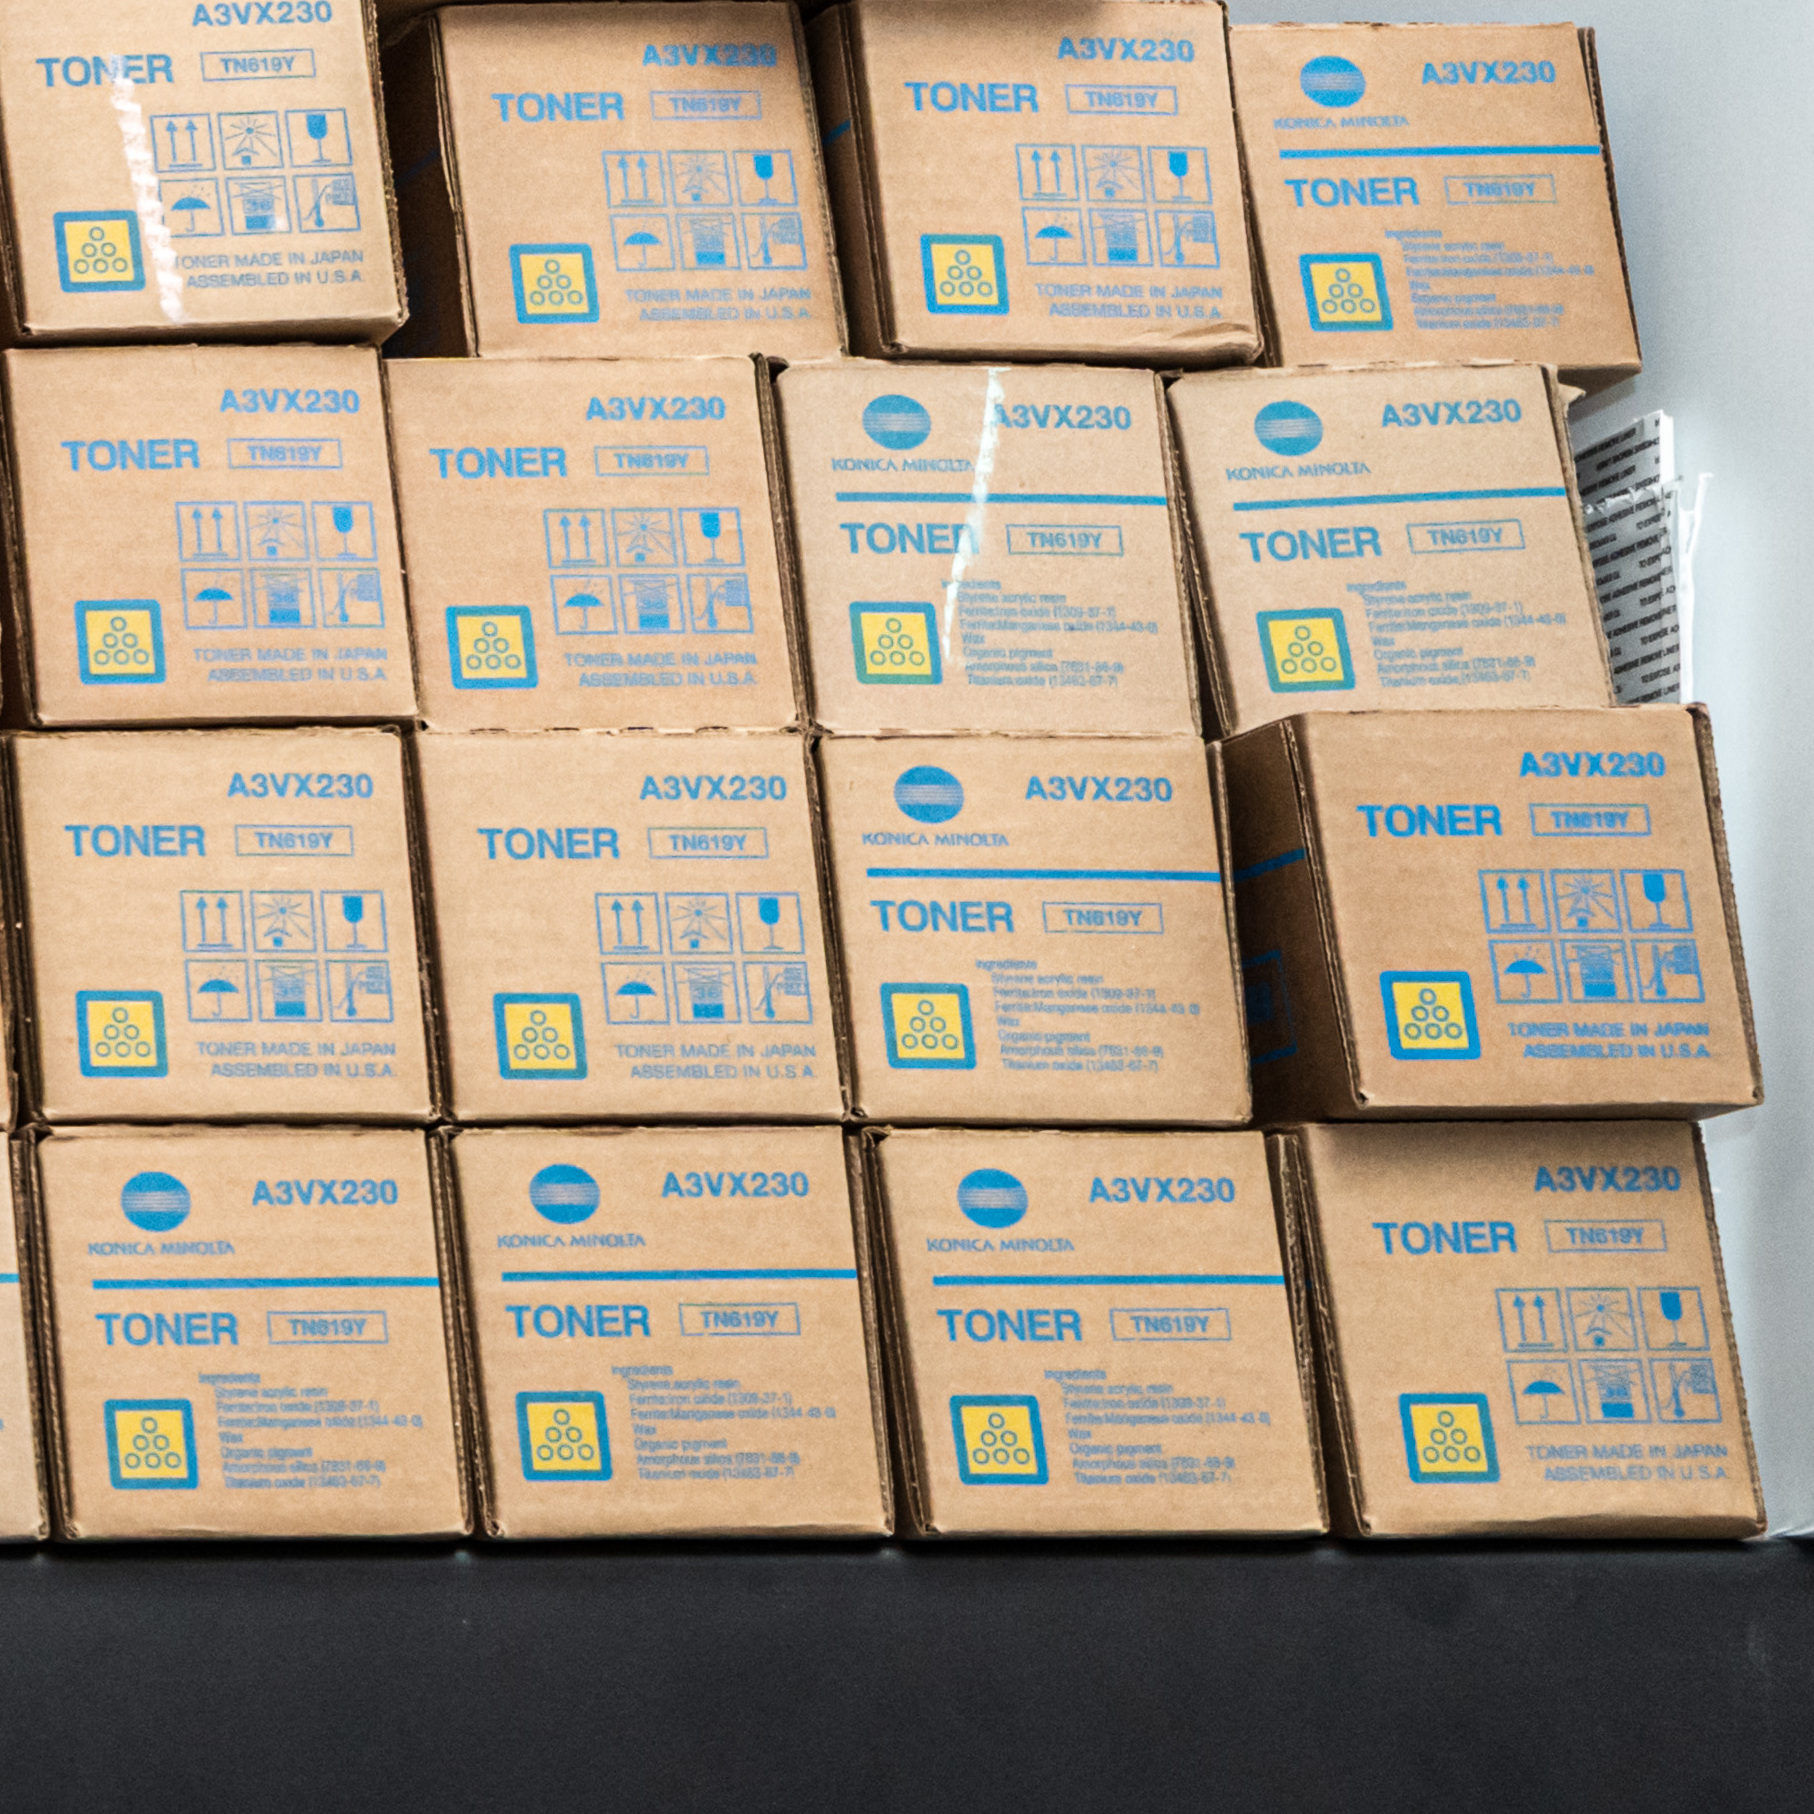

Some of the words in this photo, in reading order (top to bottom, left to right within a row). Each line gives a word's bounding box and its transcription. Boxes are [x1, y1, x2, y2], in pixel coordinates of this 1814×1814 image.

[1058, 38, 1196, 63] A3VX230
[905, 81, 1040, 114] TONER
[1085, 89, 1165, 111] TN619Y
[587, 397, 727, 422] A3VX230
[430, 448, 568, 480] TONER
[610, 451, 691, 470] TN619Y
[1027, 777, 1174, 803] A3VX230
[871, 900, 1015, 934] TONER
[1060, 906, 1145, 928] TN619Y
[1535, 1167, 1682, 1193] A3VX230
[1373, 1222, 1519, 1256] TONER
[1564, 1225, 1650, 1246] TN619Y
